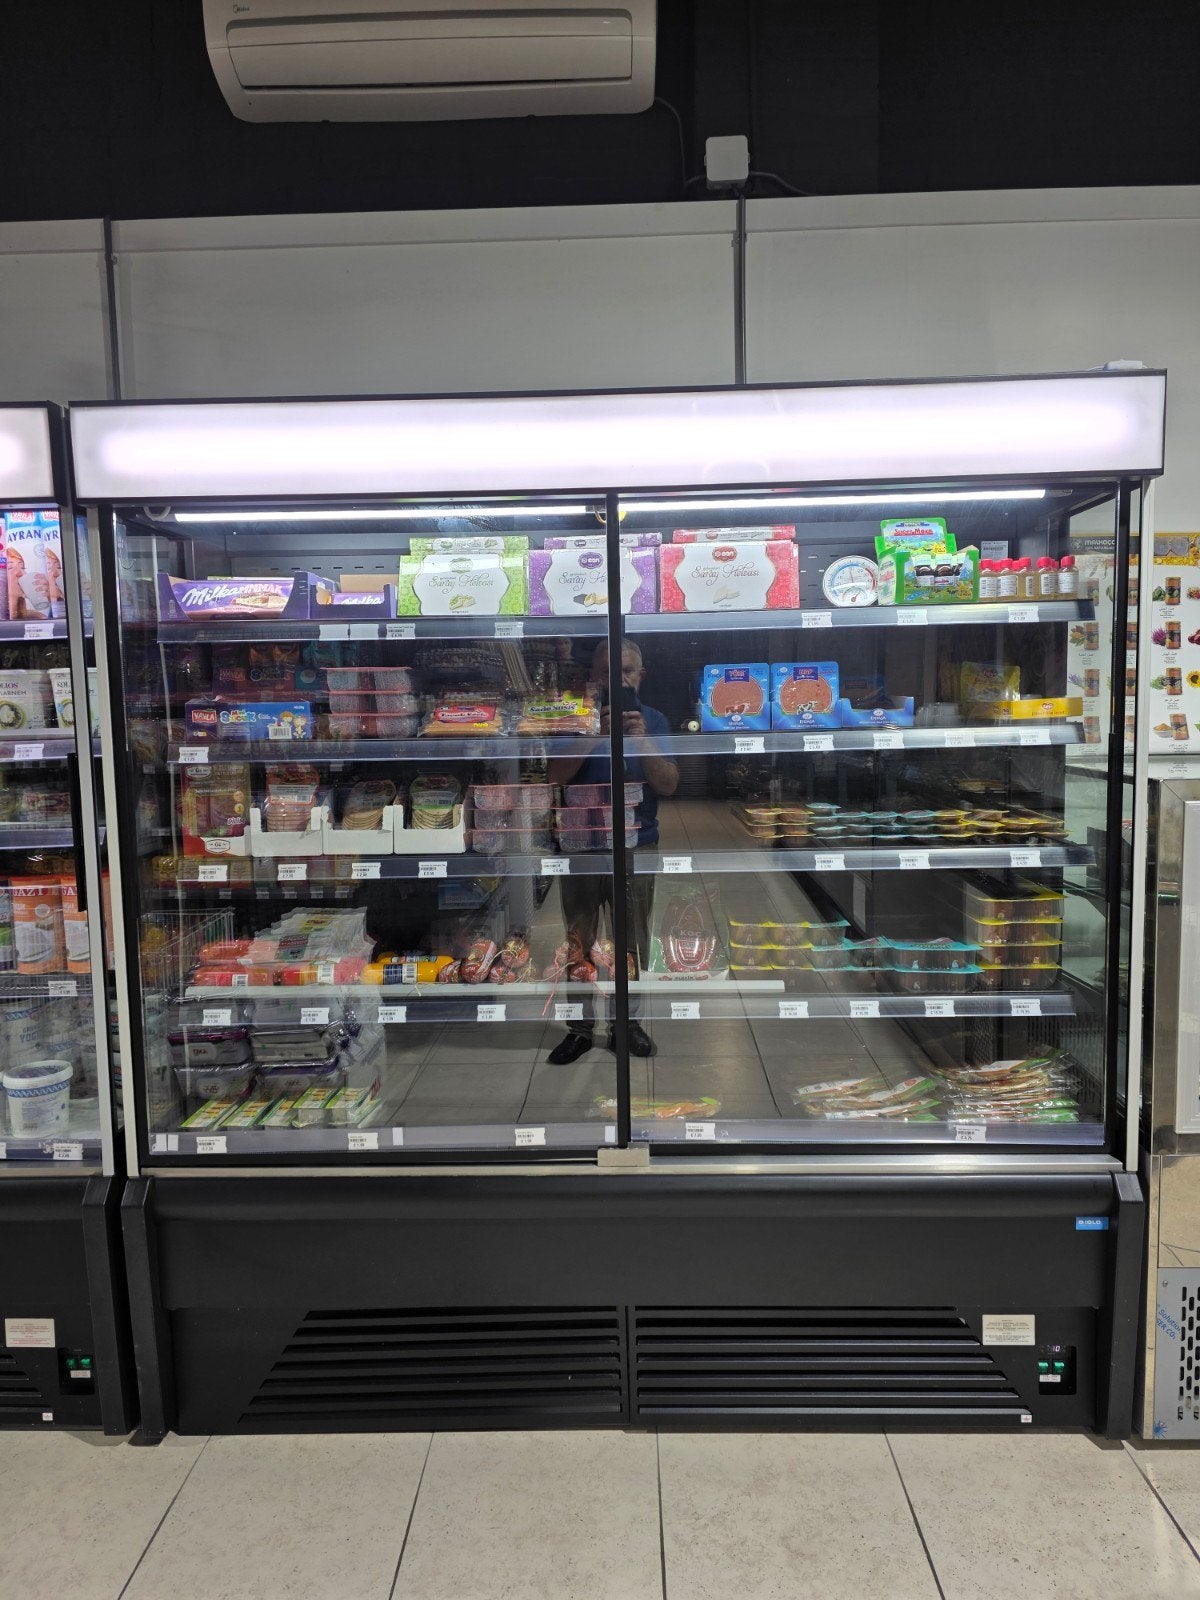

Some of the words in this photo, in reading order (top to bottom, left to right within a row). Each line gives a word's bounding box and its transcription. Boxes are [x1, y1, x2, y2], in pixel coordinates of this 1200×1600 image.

[8, 529, 41, 543] AYRAN
[558, 571, 586, 591] Saray
[691, 565, 720, 586] Saray
[181, 583, 241, 607] Milka
[193, 712, 215, 721] YAYLA
